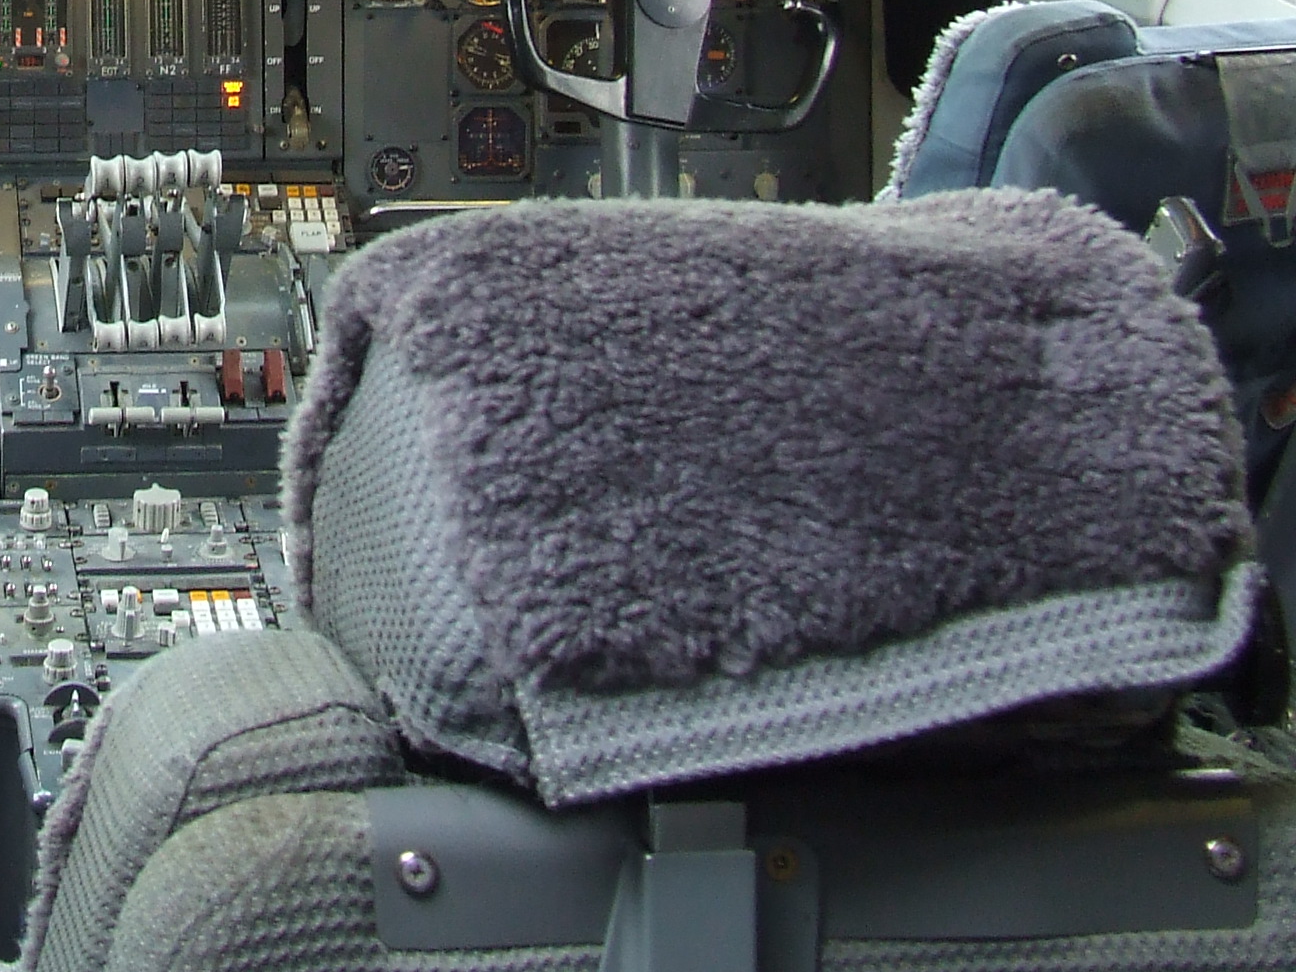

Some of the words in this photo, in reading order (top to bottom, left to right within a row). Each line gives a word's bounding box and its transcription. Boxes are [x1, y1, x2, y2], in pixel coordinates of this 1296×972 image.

[269, 4, 280, 13] UP
[309, 4, 320, 13] UP
[267, 57, 282, 65] OFF
[309, 56, 324, 64] OFF
[101, 66, 119, 77] EGT
[159, 65, 177, 76] N2
[219, 64, 231, 75] FF
